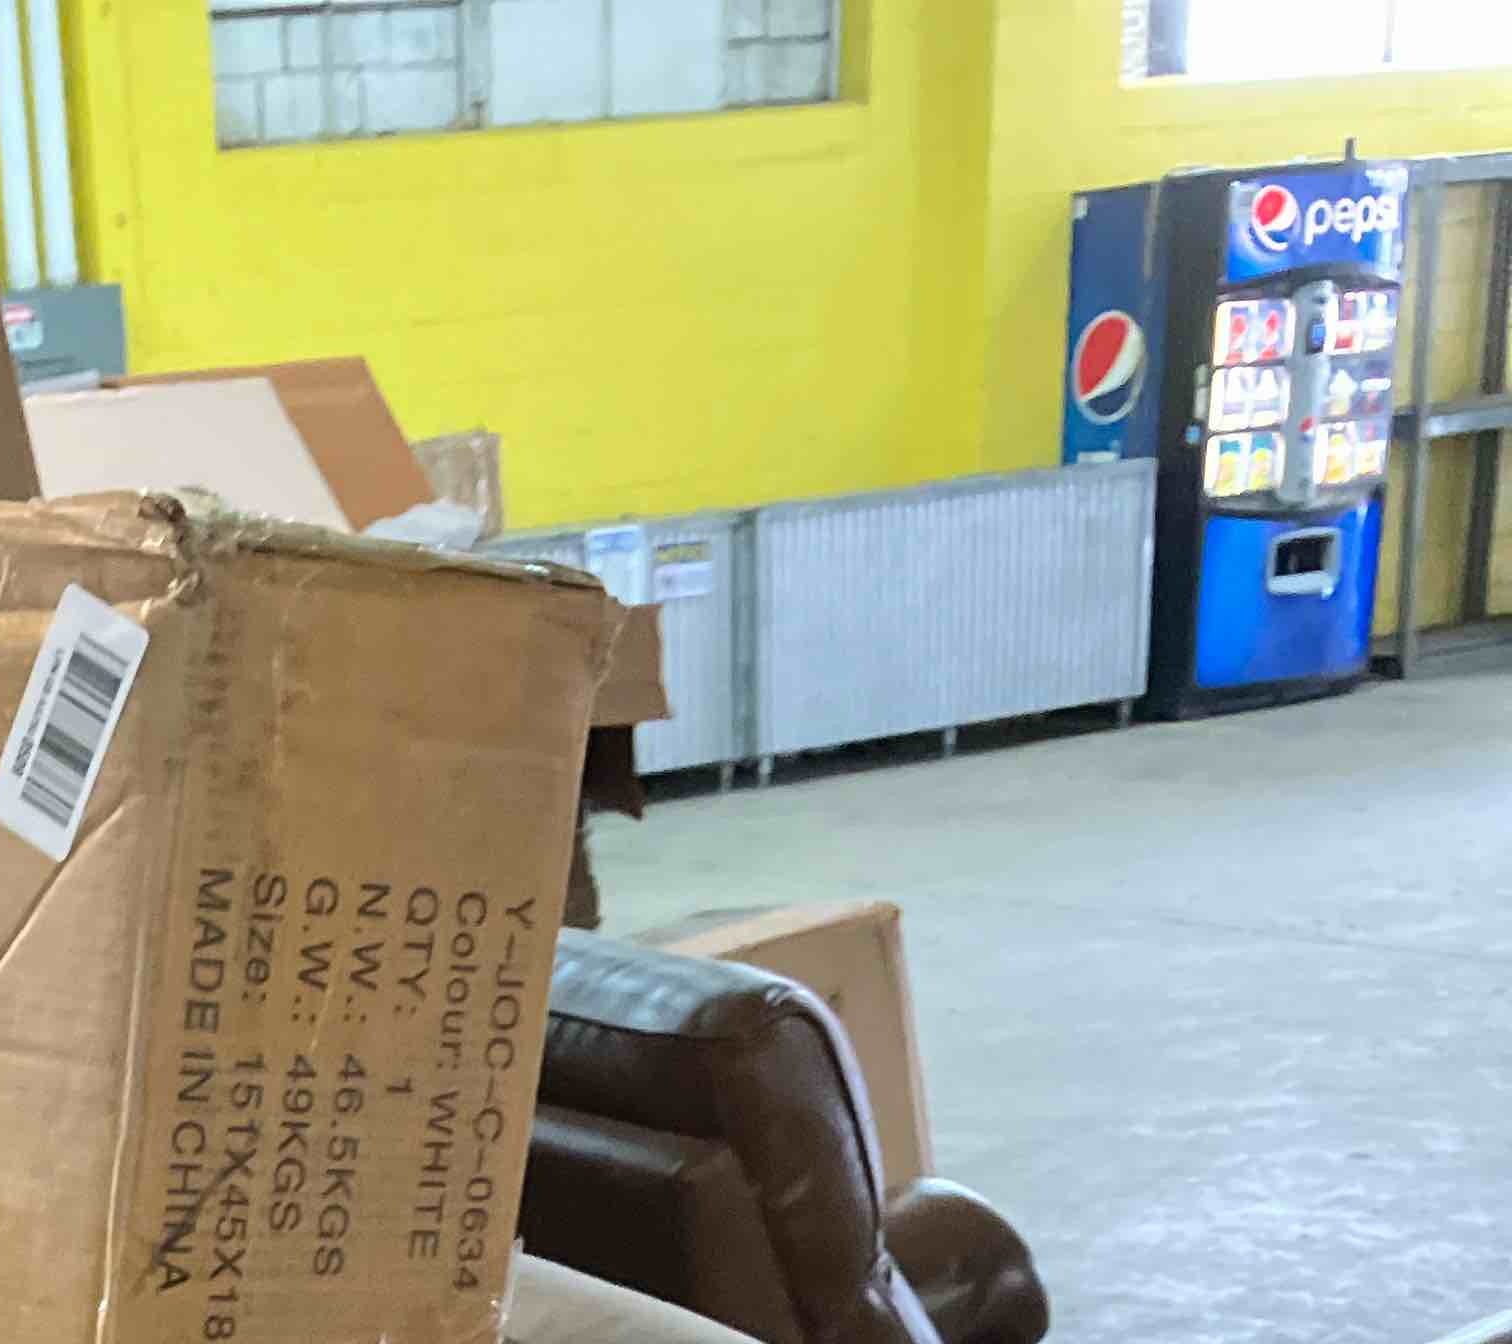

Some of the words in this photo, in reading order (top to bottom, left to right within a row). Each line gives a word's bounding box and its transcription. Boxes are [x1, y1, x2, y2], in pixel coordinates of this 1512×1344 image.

[184, 867, 234, 1045] MADE
[241, 873, 287, 1003] Size:
[392, 886, 439, 1018] QTY:
[433, 890, 488, 1071] Colour:
[176, 1050, 212, 1104] IN
[268, 1054, 318, 1232] 49KGS
[384, 1076, 414, 1096] 1
[158, 1121, 207, 1292] CHINA
[313, 1053, 367, 1276] 46.5KGS
[408, 1091, 460, 1260] WHITE
